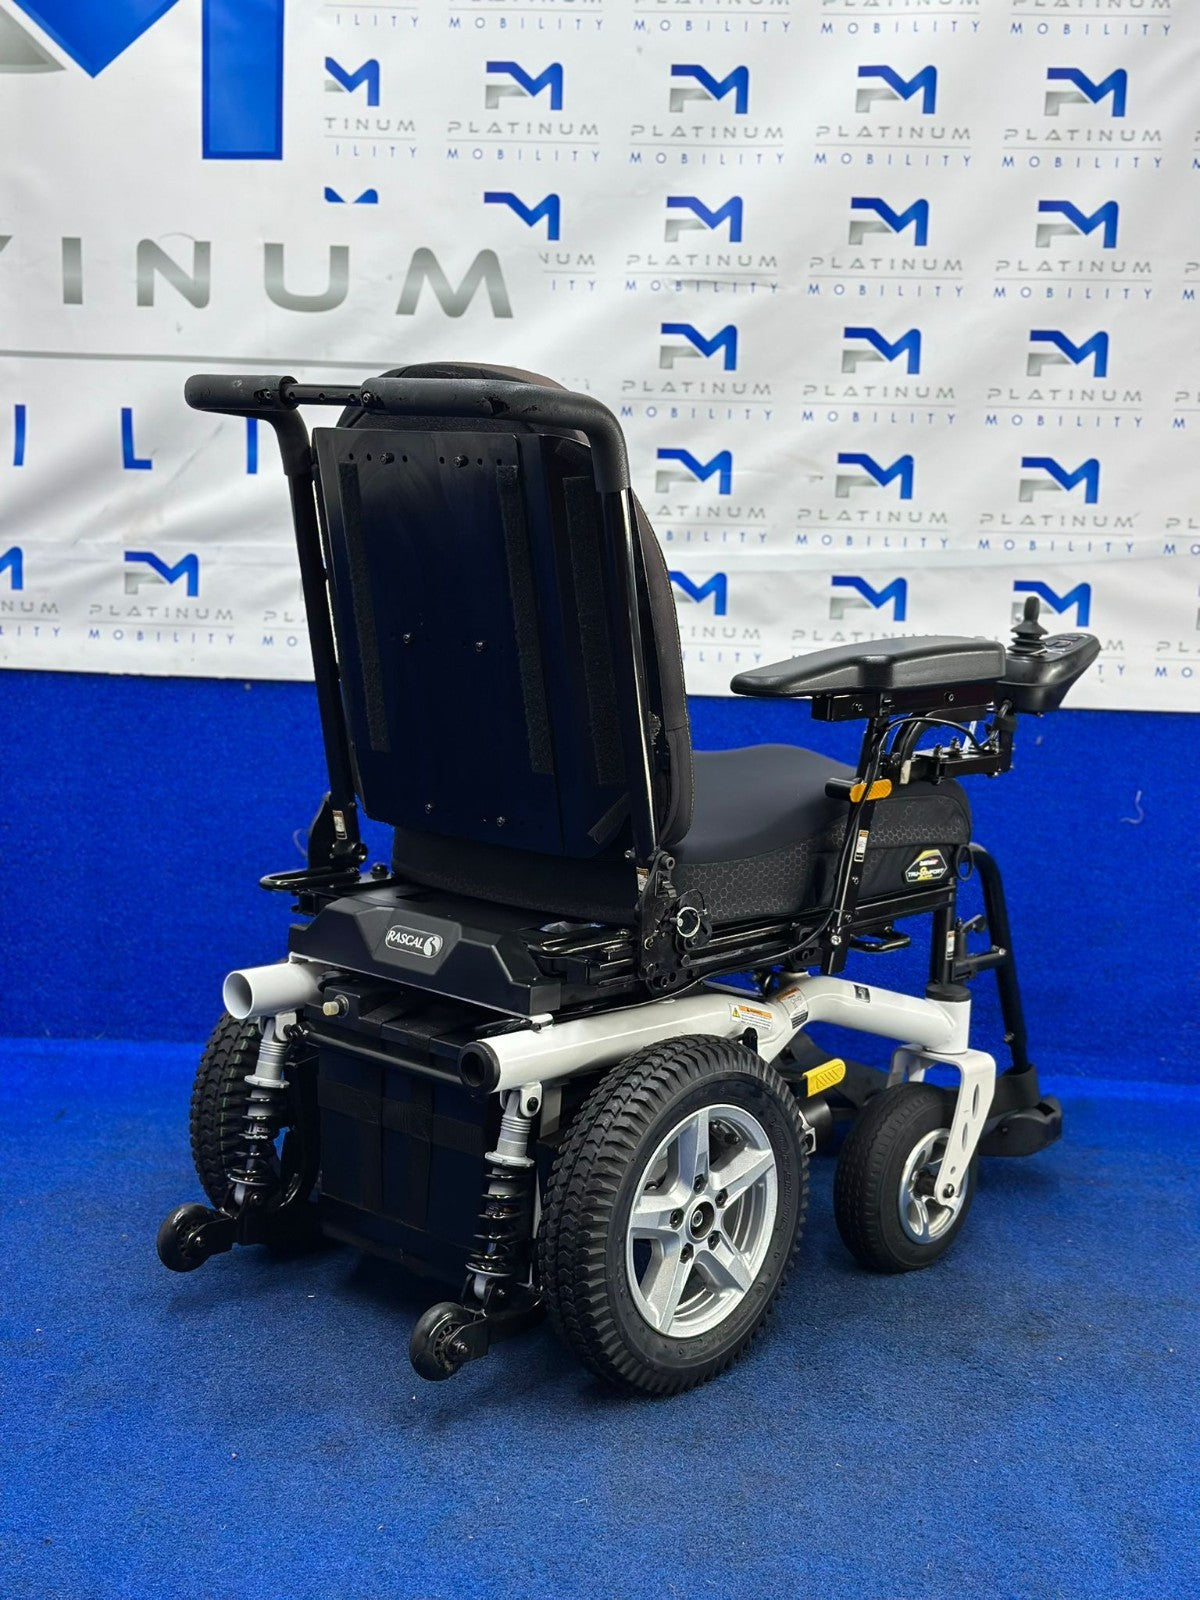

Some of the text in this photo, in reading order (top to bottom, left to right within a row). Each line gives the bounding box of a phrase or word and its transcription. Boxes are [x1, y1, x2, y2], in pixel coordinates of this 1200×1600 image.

[448, 17, 603, 31] MOBILITY
[633, 19, 790, 33] MOBILITY
[820, 21, 981, 34] MOBILITY
[1010, 22, 1171, 36] MOBILITY
[447, 121, 599, 136] PLATINUM
[630, 125, 784, 139] PLATINUM
[815, 126, 971, 140] PLATINUM
[1003, 128, 1162, 142] PLATINUM
[446, 148, 600, 162] MOBILITY
[629, 152, 785, 165] MOBILITY
[814, 154, 972, 168] MOBILITY
[1001, 156, 1162, 169] MOBILITY
[626, 253, 778, 268] PLATINUM
[809, 256, 963, 272] PLATINUM
[994, 259, 1152, 274] PLATINUM
[0, 234, 513, 319] INUM
[624, 279, 779, 293] MOBILITY
[807, 283, 963, 297] MOBILITY
[993, 286, 1152, 300] MOBILITY
[621, 380, 772, 395] PLATINUM
[802, 384, 956, 399] PLATINUM
[986, 388, 1143, 403] PLATINUM
[620, 406, 774, 421] MOBILITY
[801, 410, 956, 425] MOBILITY
[985, 414, 1143, 428] MOBILITY
[645, 504, 766, 519] ATINUM
[797, 508, 949, 524] PLATINUM
[979, 512, 1134, 528] PLATINUM
[796, 534, 949, 549] MOBILITY
[977, 538, 1135, 553] MOBILITY
[89, 603, 235, 620] PLATINUM
[88, 629, 236, 644] MOBILITY
[679, 626, 761, 640] INUM
[387, 930, 424, 949] RASCAL
